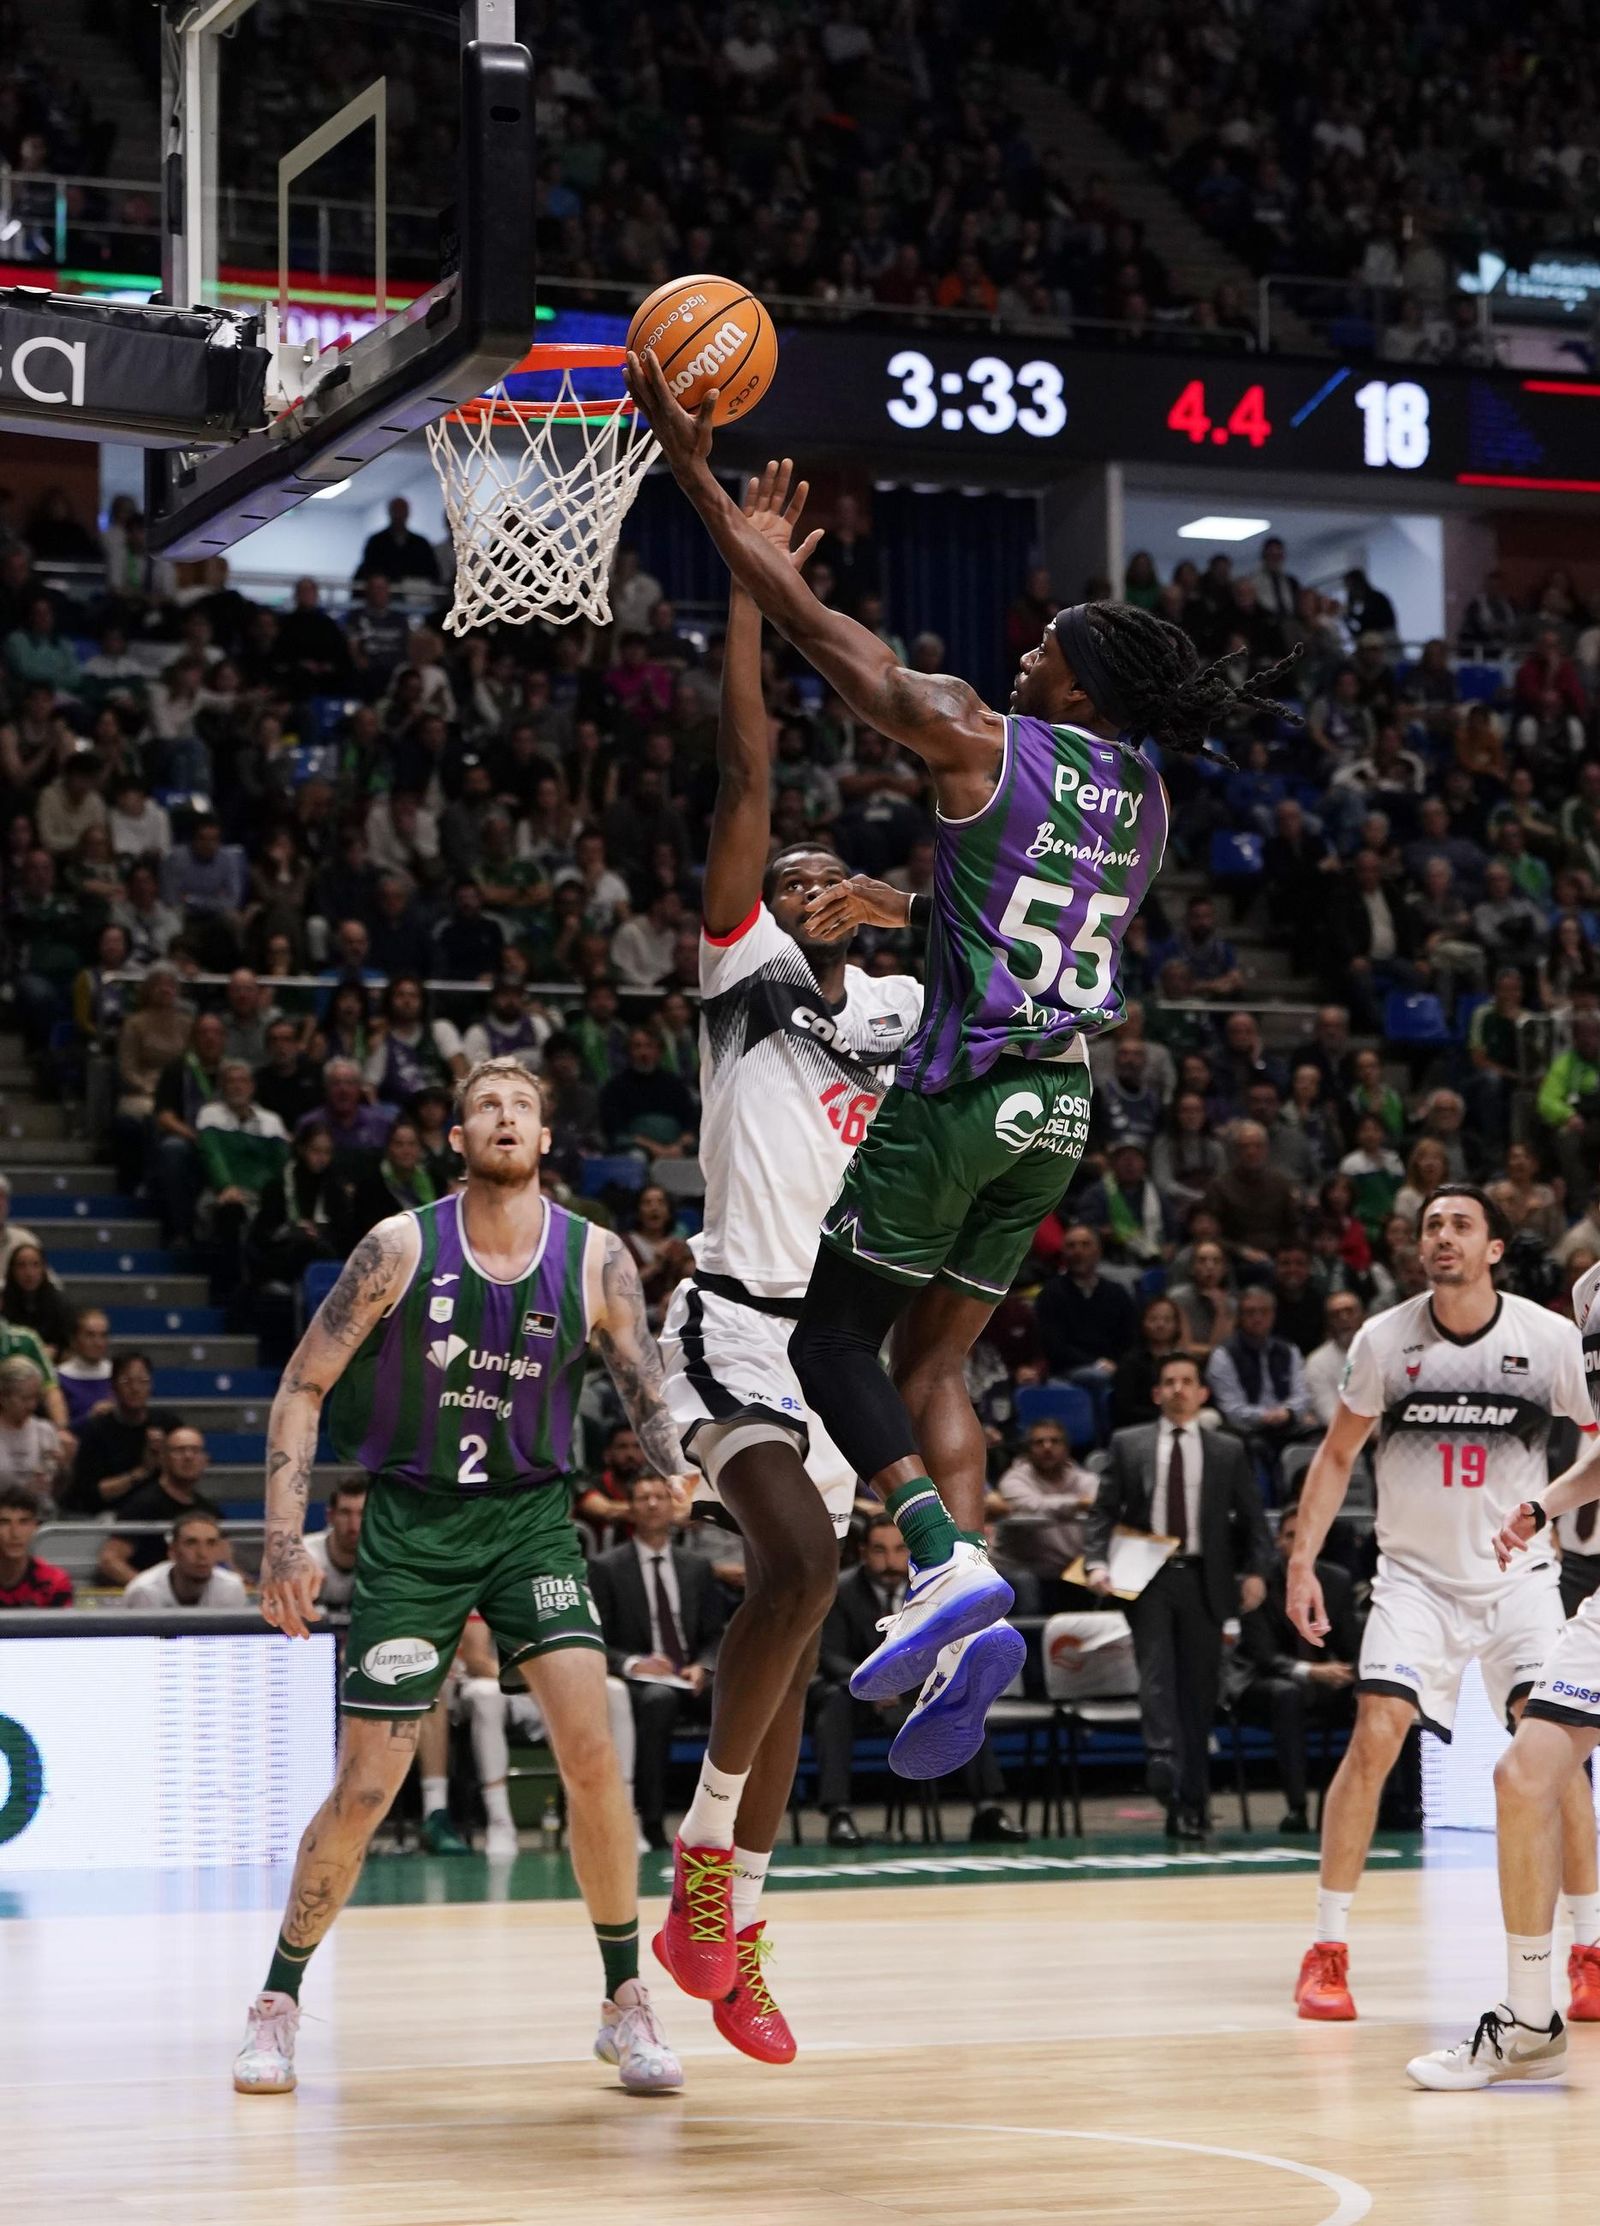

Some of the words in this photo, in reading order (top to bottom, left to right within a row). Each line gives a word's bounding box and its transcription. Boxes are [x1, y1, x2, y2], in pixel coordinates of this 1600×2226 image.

[0, 336, 86, 407] a
[886, 350, 1067, 438] 3:33
[1167, 379, 1272, 447] 4.4
[1355, 380, 1430, 469] 18
[1054, 764, 1144, 828] Perry
[991, 875, 1130, 1009] 55
[1043, 1118, 1072, 1138] DEL
[457, 1434, 489, 1484] 2
[1437, 1443, 1488, 1489] 19
